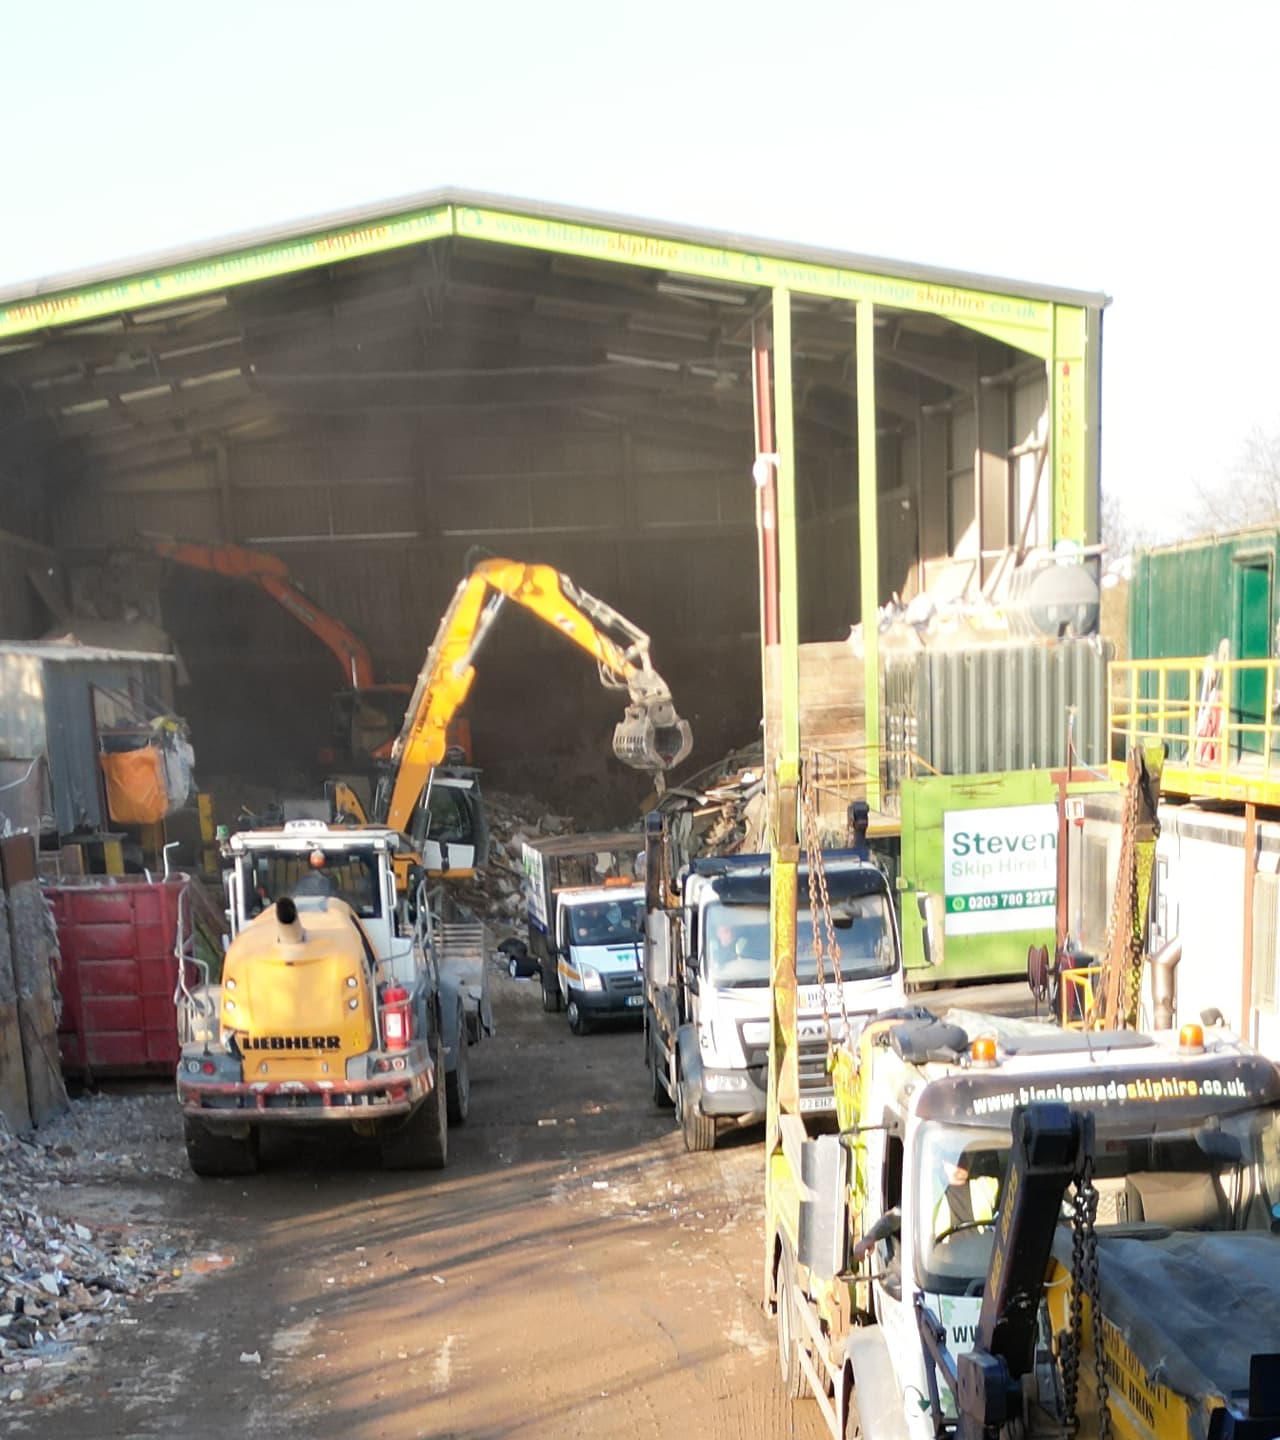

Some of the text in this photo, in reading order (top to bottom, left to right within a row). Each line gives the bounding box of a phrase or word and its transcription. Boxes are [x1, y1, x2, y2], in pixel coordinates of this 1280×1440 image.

[951, 861, 993, 879] Skip
[998, 857, 1037, 873] Hire
[968, 890, 1056, 910] 0203 780 2277
[243, 1035, 341, 1050] LIEBHERR
